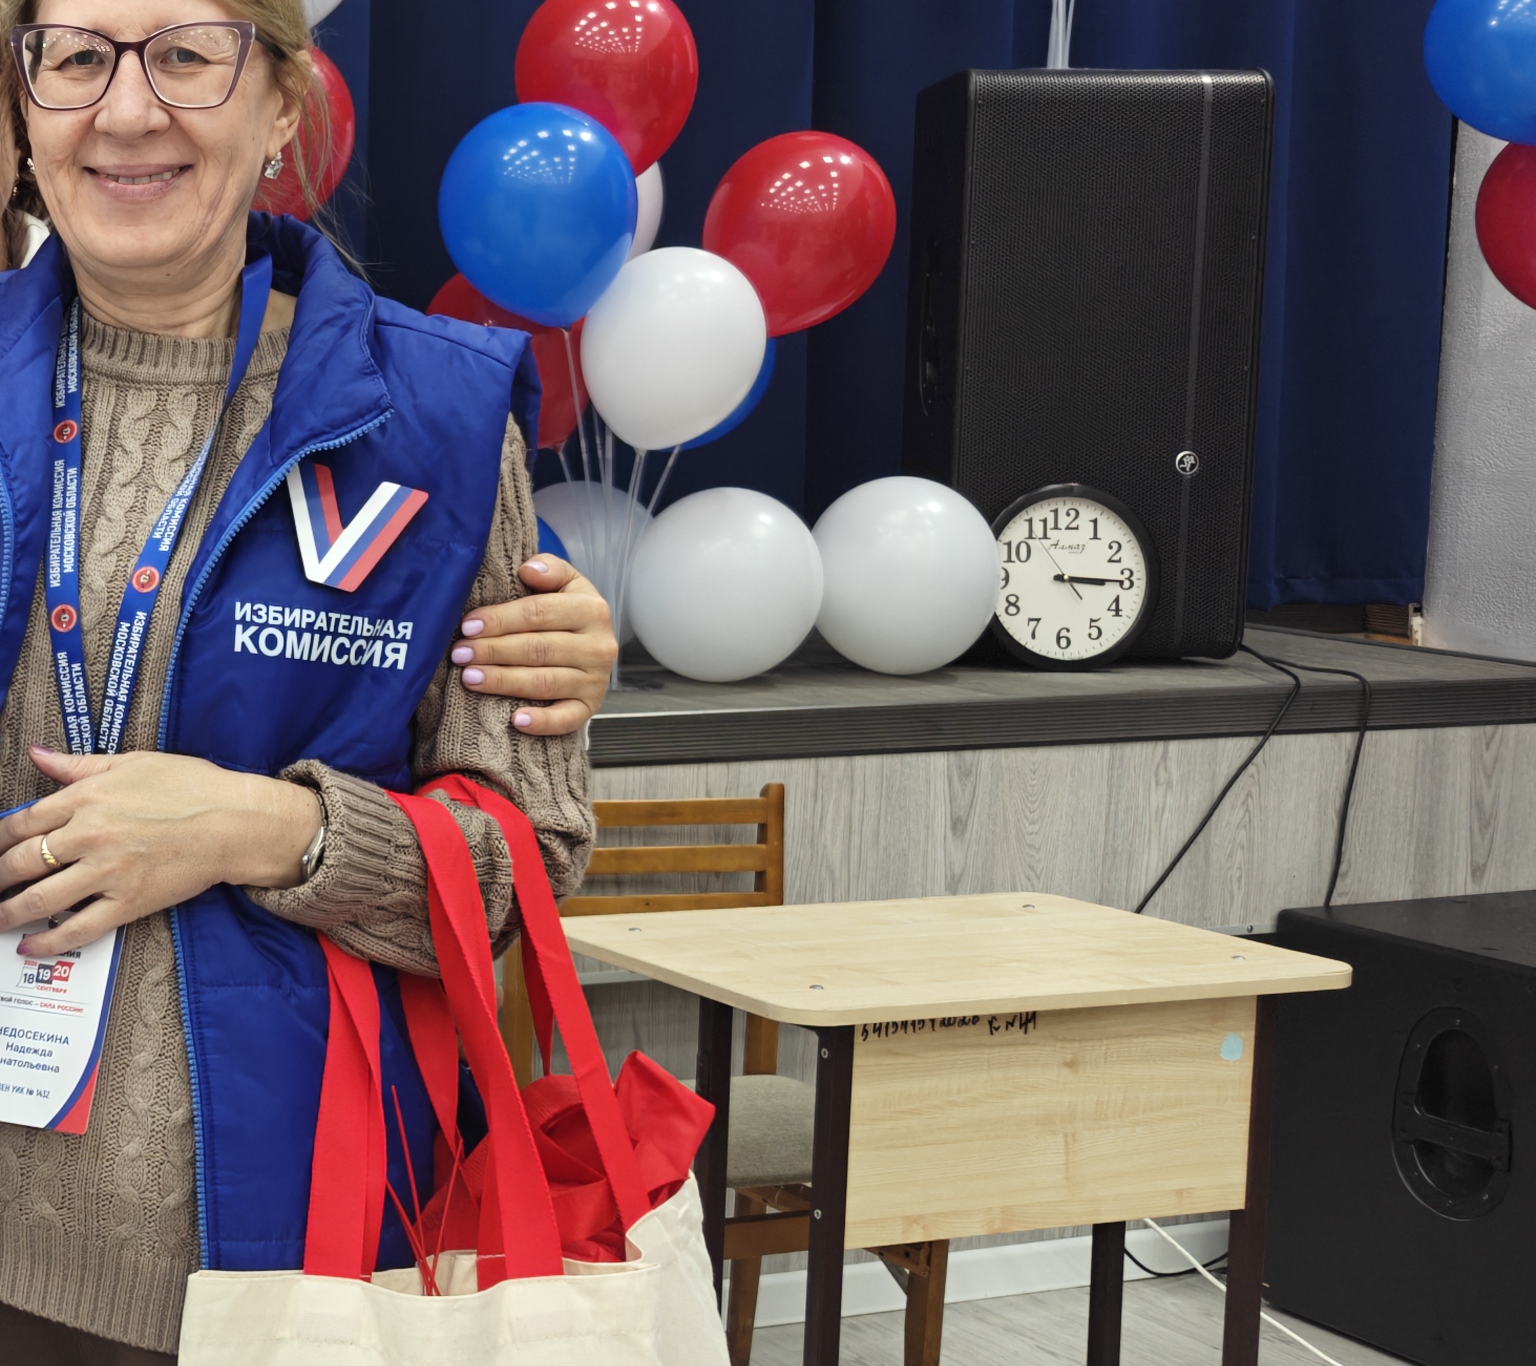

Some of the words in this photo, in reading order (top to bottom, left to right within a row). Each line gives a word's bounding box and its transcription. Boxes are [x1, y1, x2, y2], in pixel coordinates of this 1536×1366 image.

[52, 459, 65, 510] КОМИССИЯ
[66, 467, 78, 510] ОБЛАСТИ
[152, 497, 180, 539] ОБЛАСТИ
[159, 498, 189, 552] КОМИССИЯ
[1024, 517, 1051, 540] 11
[1049, 508, 1080, 530] 12
[1088, 518, 1102, 540] 1
[50, 511, 64, 588] ИЗБИРАТЕЛЬНАЯ
[63, 511, 77, 573] МОСКОВСКОЙ
[1002, 540, 1031, 563] 10
[1107, 541, 1122, 563] 2
[1119, 568, 1134, 590] 3
[1004, 594, 1020, 616] 8
[1107, 595, 1123, 617] 4
[235, 601, 413, 640] ИЗБИРАТЕЛЬНАЯ
[1027, 618, 1042, 639] 7
[1088, 618, 1102, 640] 5
[234, 624, 408, 670] КОМИССИЯ
[1056, 627, 1071, 650] 6
[106, 621, 131, 698] МОСКОВСКОЙ
[117, 611, 148, 703] ИЗБИРАТЕЛЬНАЯ
[57, 651, 76, 713] КОМИССИЯ
[71, 662, 88, 713] ОБЛАСТИ
[97, 698, 115, 750] ОБЛАСТИ
[23, 972, 35, 984] 18
[38, 968, 51, 981] 19
[54, 965, 70, 978] 20
[36, 985, 68, 994] СЕНТЯБРЯ
[13, 998, 34, 1006] ГОЛОС
[5, 1041, 54, 1058] Надежда
[11, 1085, 26, 1095] УИК
[36, 1089, 51, 1100] 1432
